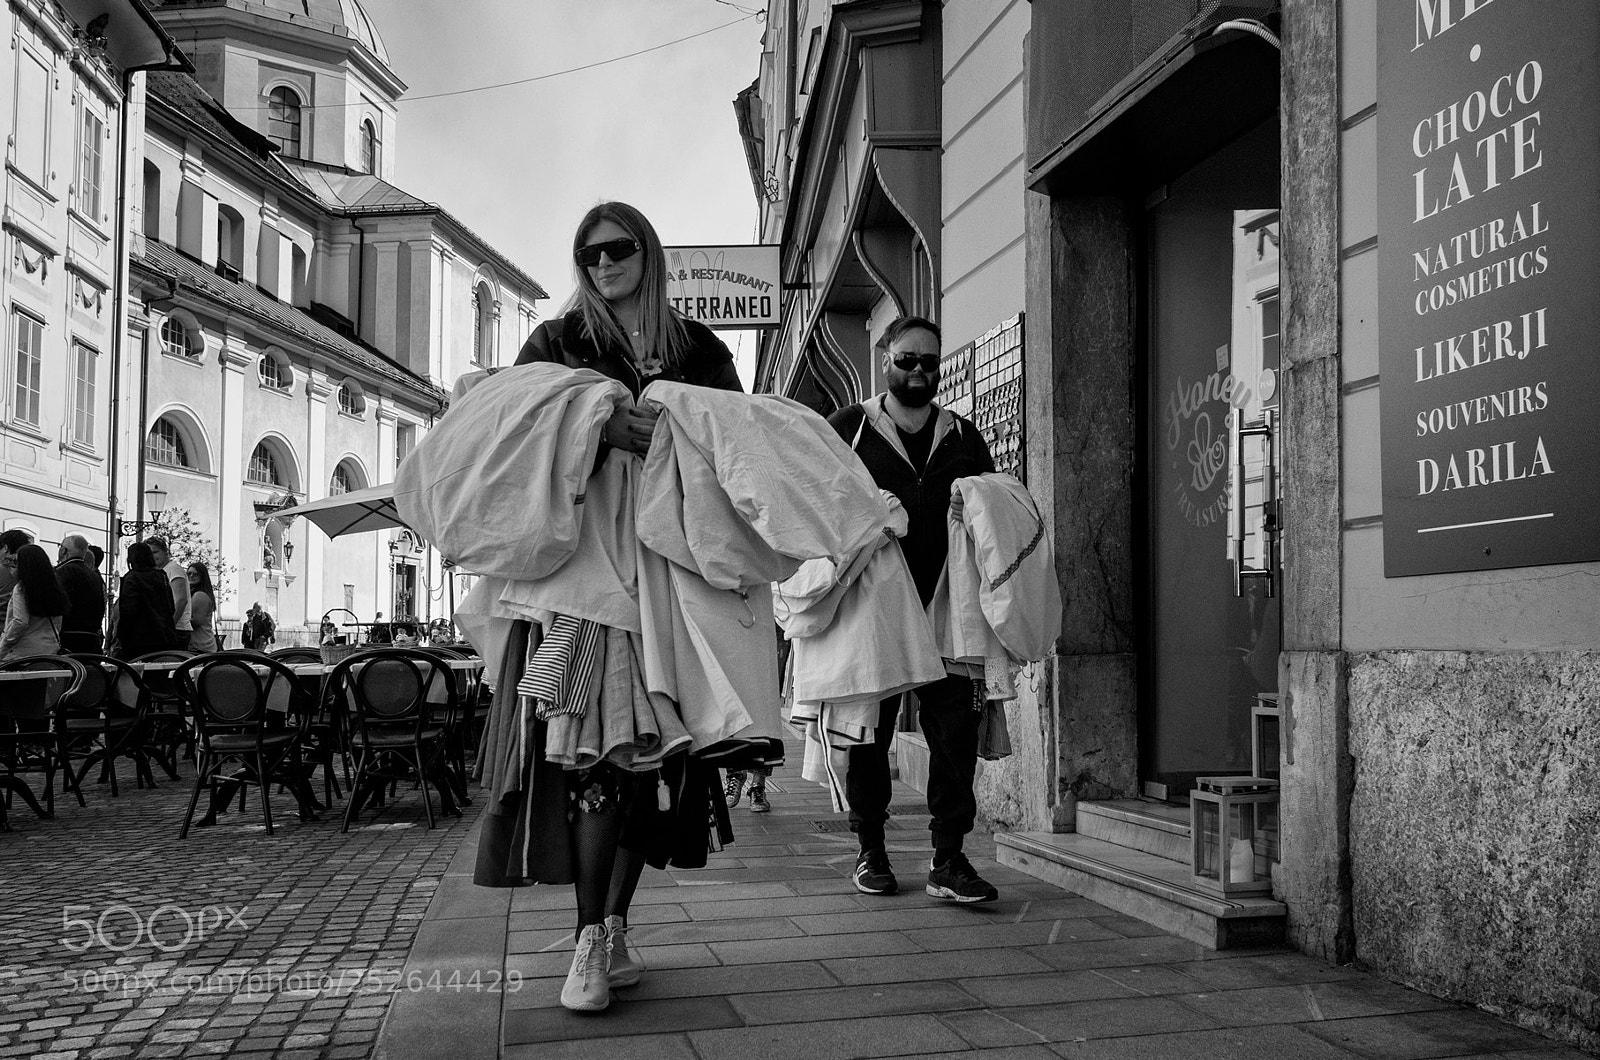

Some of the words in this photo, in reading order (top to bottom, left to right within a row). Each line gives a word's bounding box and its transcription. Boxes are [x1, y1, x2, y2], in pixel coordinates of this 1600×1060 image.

[1412, 60, 1543, 158] CHOCO
[1412, 110, 1543, 223] LATE
[1412, 201, 1549, 282] NATURAL
[667, 296, 772, 320] TERRANEO
[678, 269, 688, 281] &
[691, 268, 774, 293] RESTAURANT
[1415, 245, 1549, 316] COSMETICS
[1414, 307, 1549, 383] LIKERJI
[1416, 381, 1549, 437] SOUVENIRS
[1416, 435, 1555, 496] DARILA
